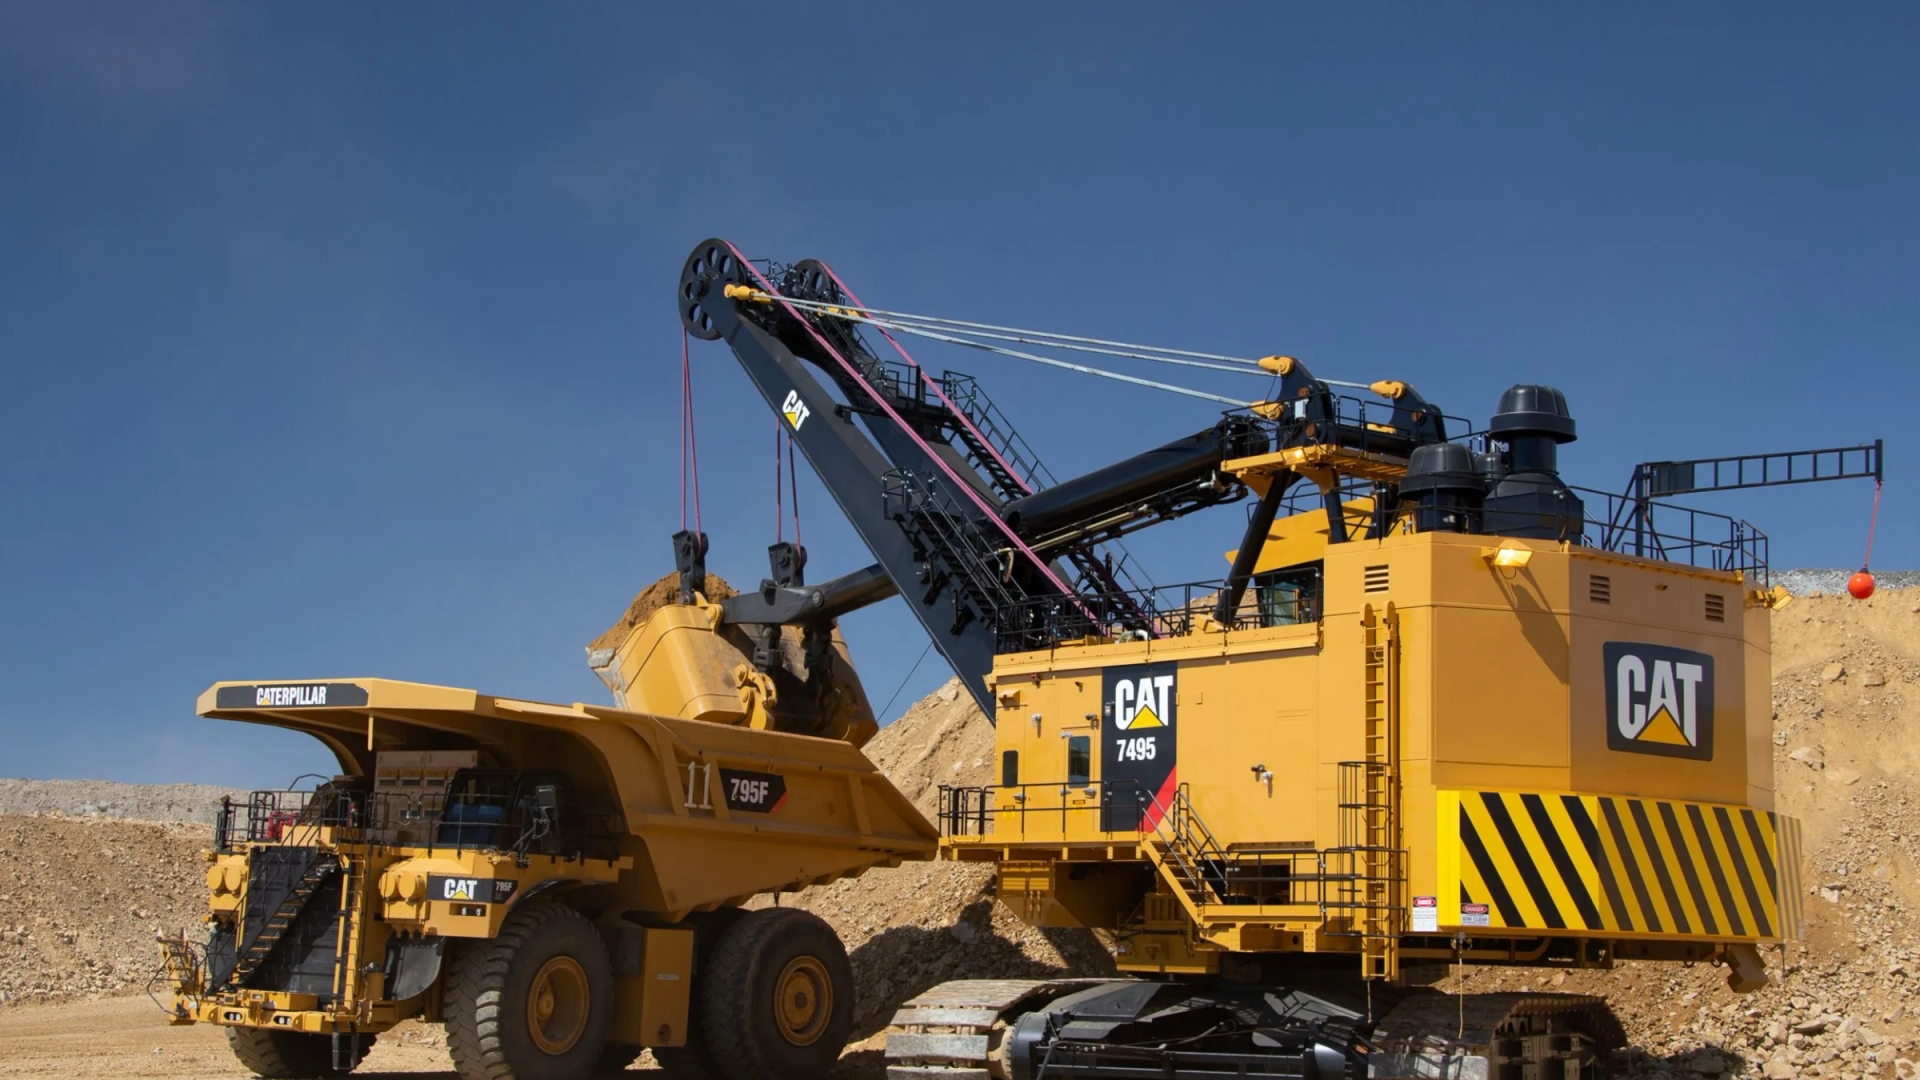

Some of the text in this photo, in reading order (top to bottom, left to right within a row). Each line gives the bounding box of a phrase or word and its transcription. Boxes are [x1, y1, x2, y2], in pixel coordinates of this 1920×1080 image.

[782, 390, 810, 431] CAT
[256, 686, 326, 706] CATERPILLAR
[1115, 675, 1174, 731] CAT
[1617, 654, 1702, 747] CAT
[1116, 737, 1156, 762] 7495
[684, 761, 711, 809] 11
[731, 778, 769, 804] 795F
[444, 879, 478, 900] CAT
[496, 882, 513, 892] 795F
